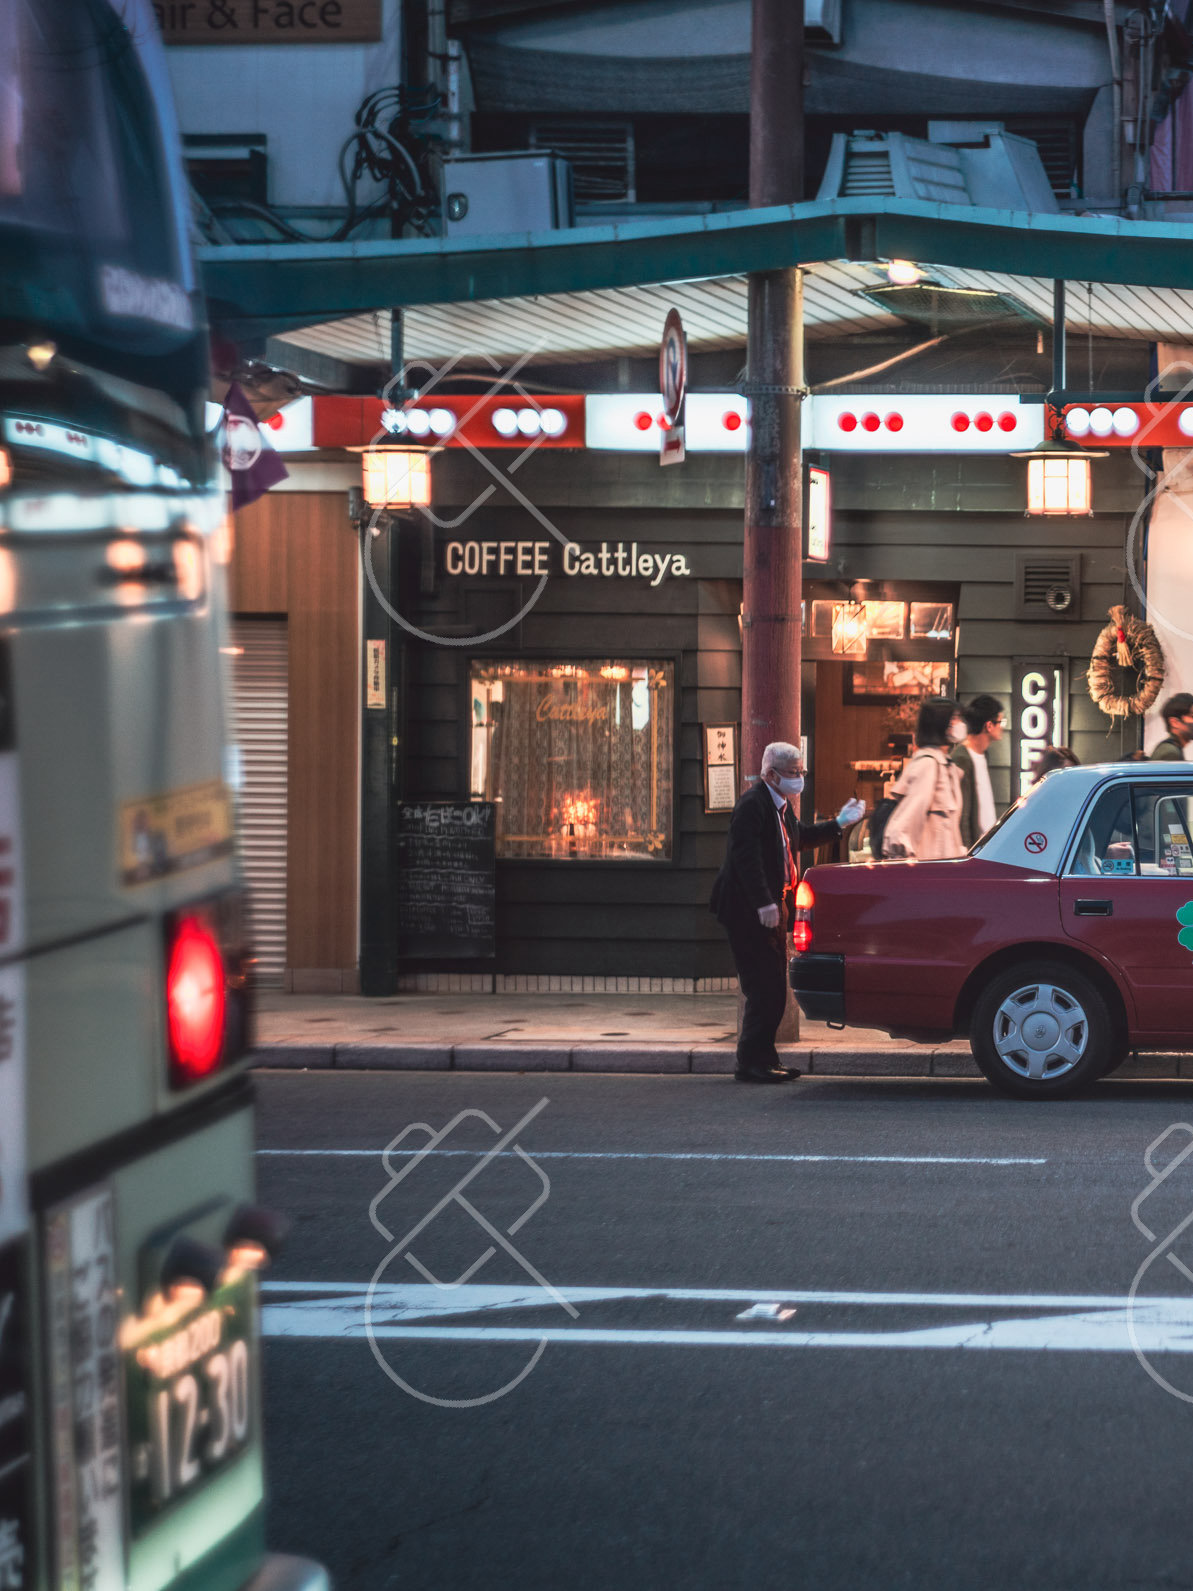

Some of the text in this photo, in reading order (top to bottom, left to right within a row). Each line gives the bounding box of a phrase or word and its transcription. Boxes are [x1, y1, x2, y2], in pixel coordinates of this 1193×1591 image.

[207, 0, 239, 30] &
[253, 0, 342, 29] Face
[446, 541, 691, 587] COFFEE Cattleya
